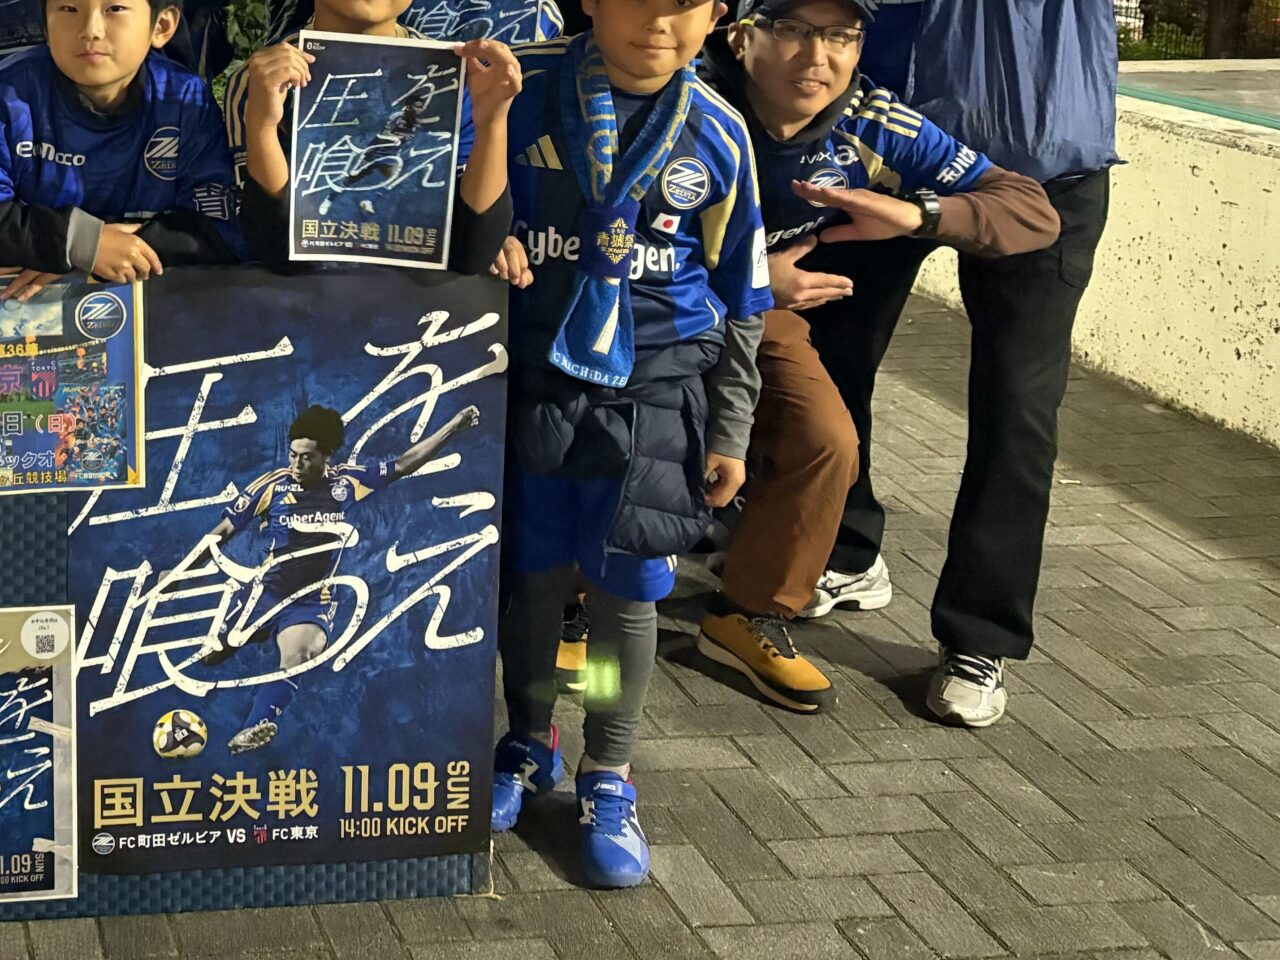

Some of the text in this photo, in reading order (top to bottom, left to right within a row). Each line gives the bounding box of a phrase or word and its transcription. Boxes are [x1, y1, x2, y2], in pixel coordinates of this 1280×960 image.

[297, 64, 459, 132] 圧を
[302, 219, 381, 242] 国立決戦
[68, 311, 509, 535] 圧を
[279, 511, 346, 529] CyberAgent
[76, 491, 500, 718] 喰らえ
[93, 760, 470, 830] 国立決戦 11.09 SUN
[119, 825, 319, 849] FC町田ゼルビア VS FC東京
[339, 815, 468, 838] 14:00 KICK OFF
[35, 853, 45, 873] SUN
[10, 875, 30, 884] KICK
[30, 873, 45, 882] OFF
